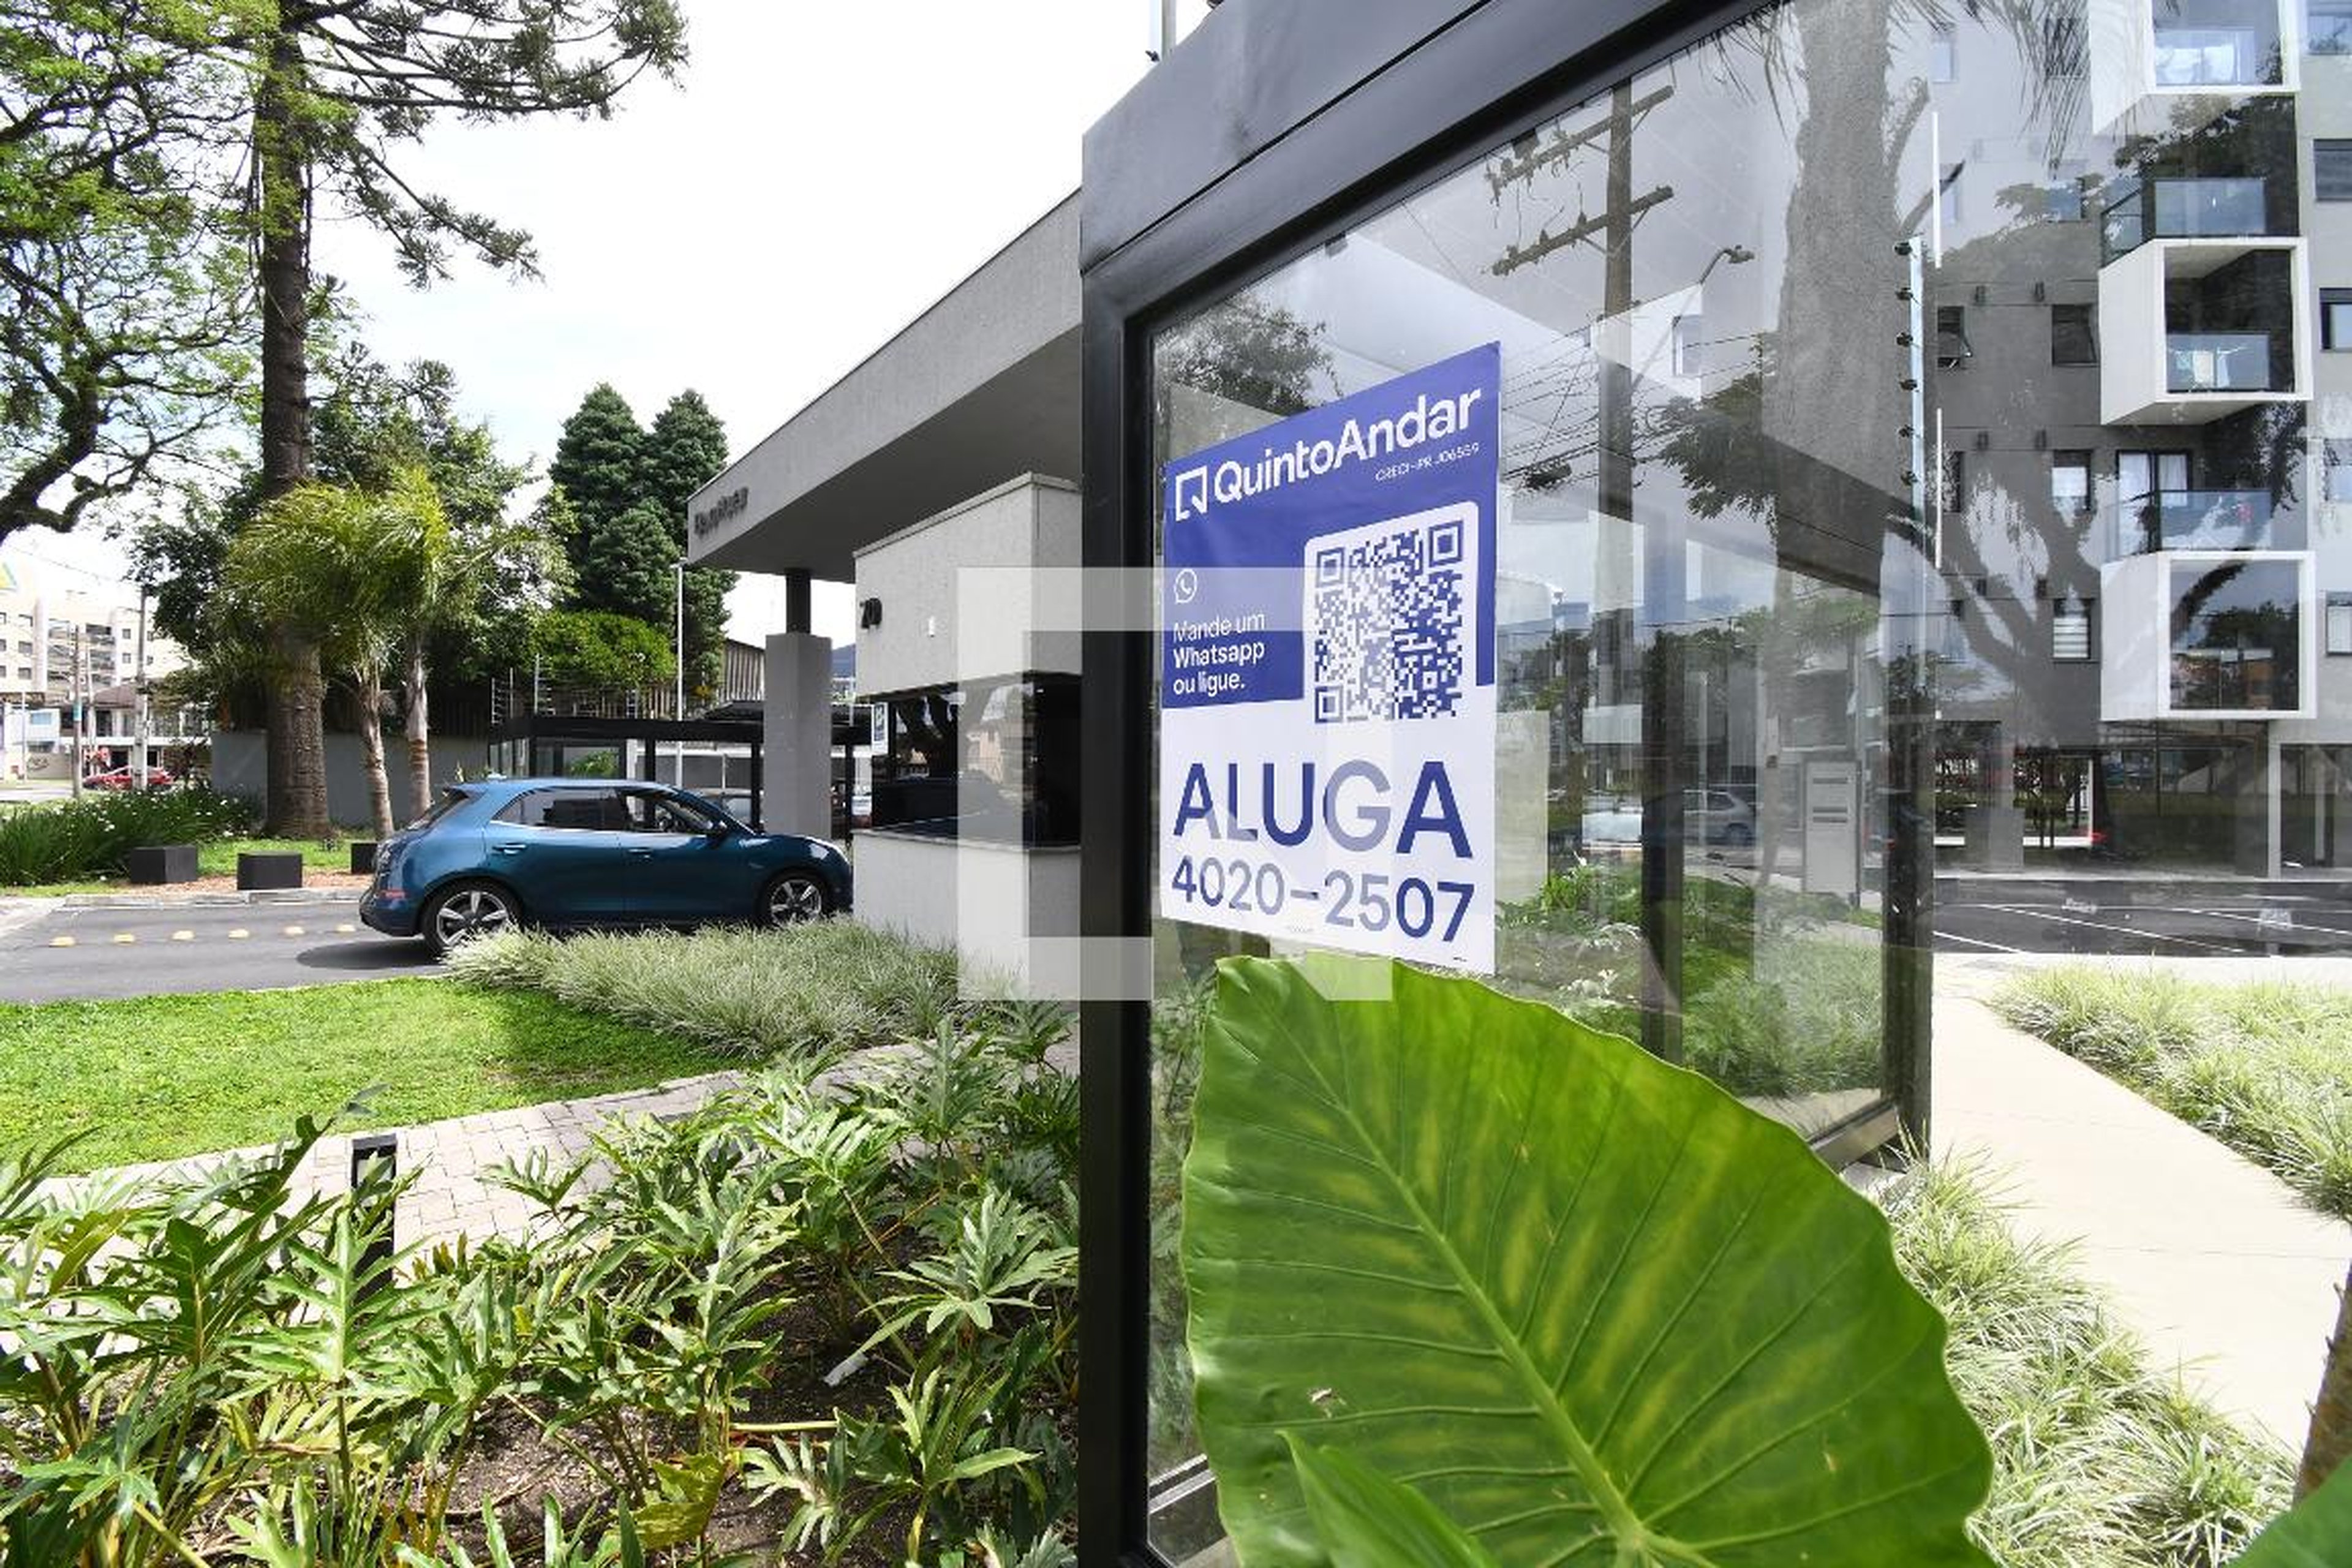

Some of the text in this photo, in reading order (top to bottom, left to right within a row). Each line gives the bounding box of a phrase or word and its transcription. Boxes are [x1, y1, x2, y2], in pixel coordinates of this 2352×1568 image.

[1214, 388, 1481, 505] QuintoAndar
[1173, 642, 1265, 668] Whatsapp
[1174, 614, 1265, 642] Mande um
[1173, 671, 1245, 697] ou ligue.
[1173, 760, 1473, 858] ALUGA
[1172, 855, 1474, 942] 4020-2507
